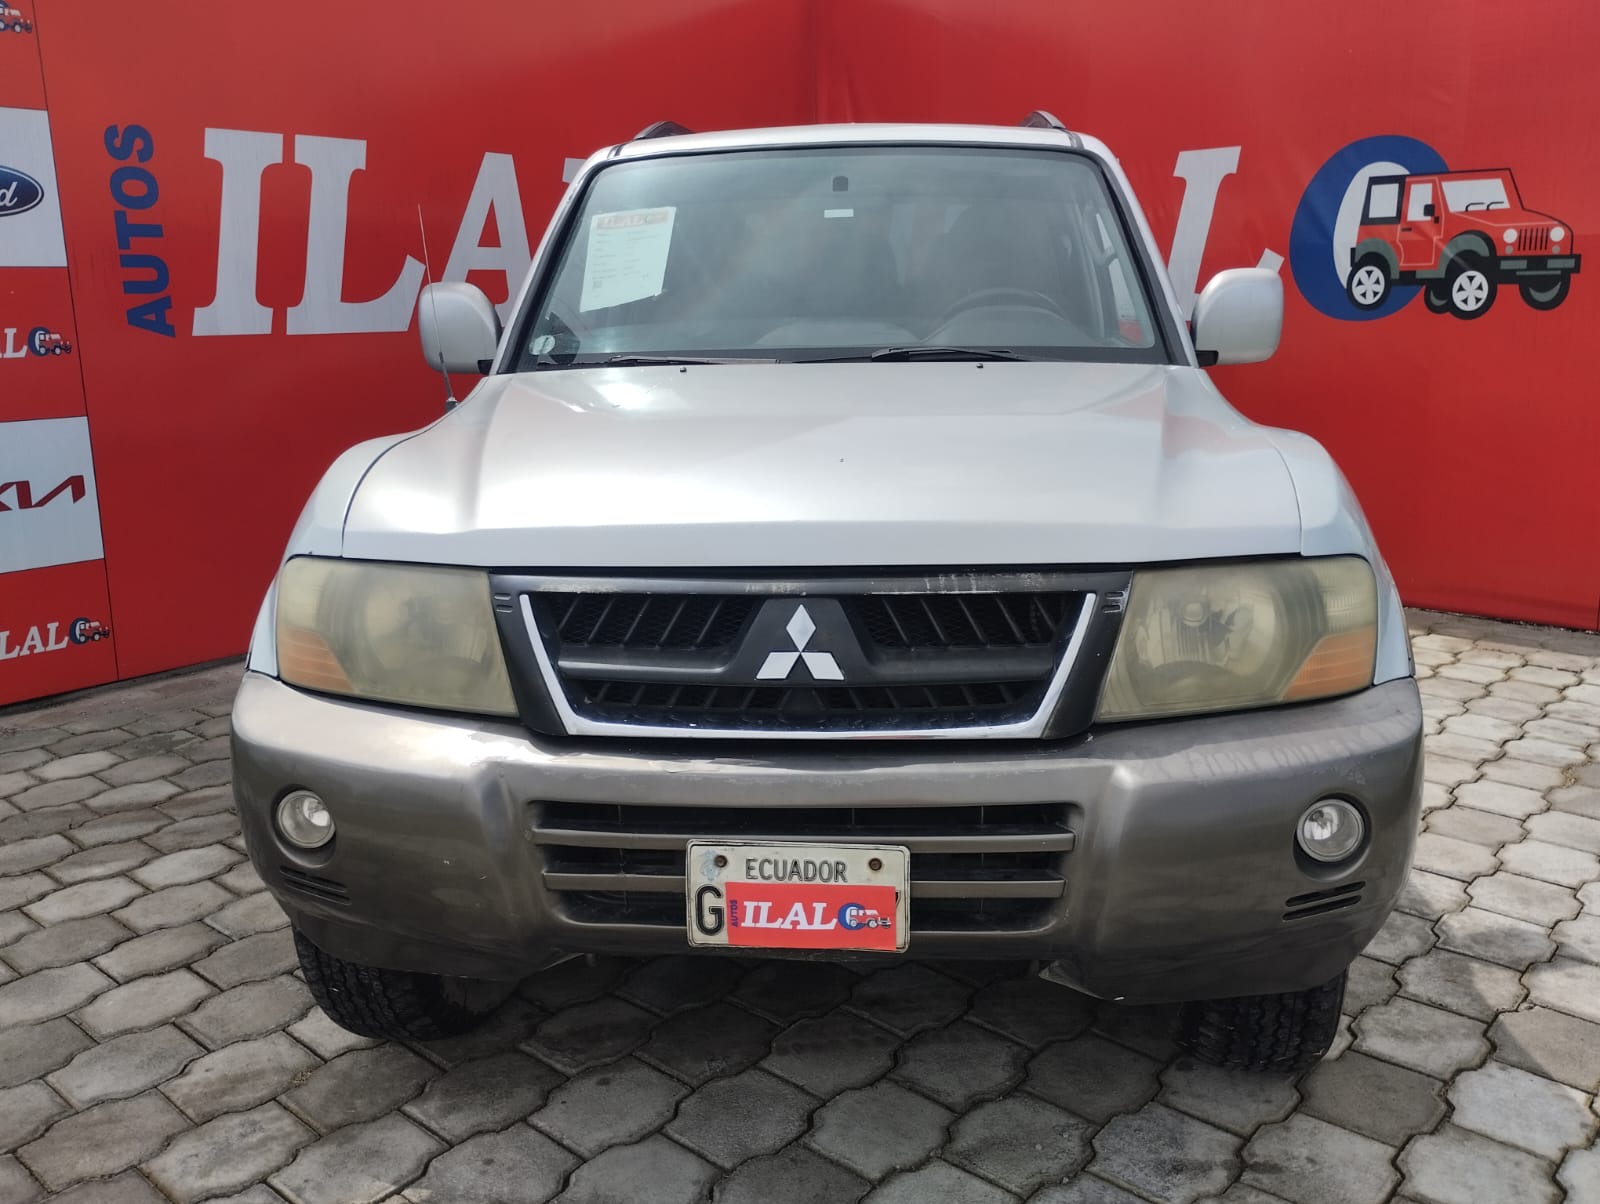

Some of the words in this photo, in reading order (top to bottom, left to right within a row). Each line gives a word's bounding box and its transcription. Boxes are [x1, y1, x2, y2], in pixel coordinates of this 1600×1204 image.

[104, 124, 176, 338] AUTOS
[745, 857, 848, 883] ECUADOR
[730, 899, 738, 928] AUTOS
